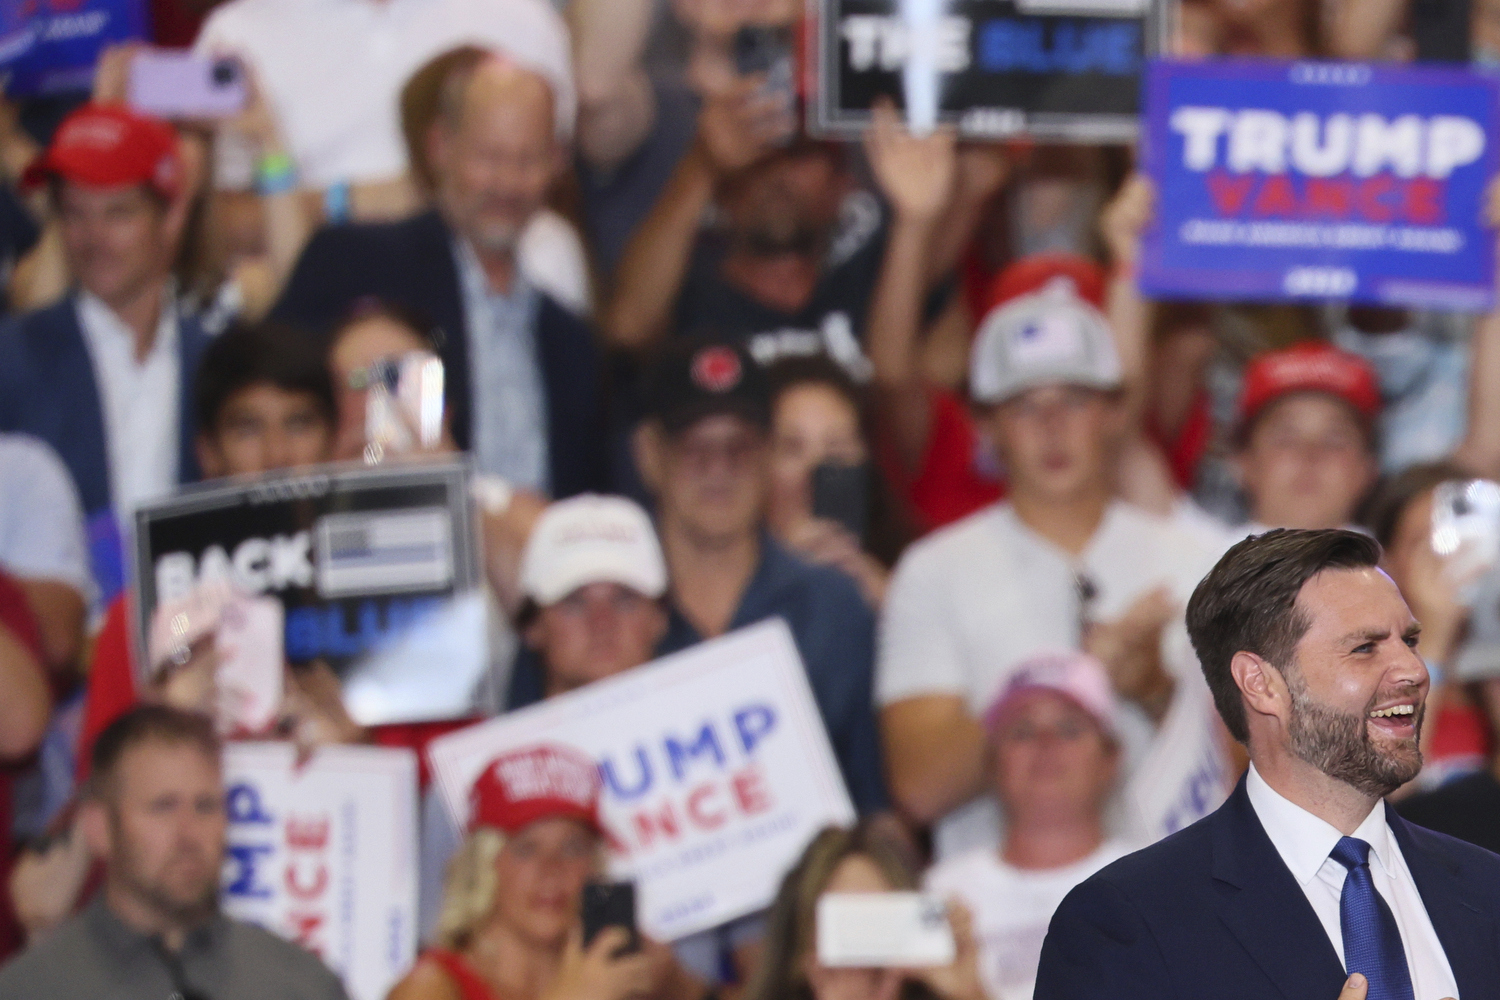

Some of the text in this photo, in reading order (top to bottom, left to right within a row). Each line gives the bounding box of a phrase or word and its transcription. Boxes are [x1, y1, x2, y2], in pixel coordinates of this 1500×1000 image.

[978, 17, 1141, 75] BLUE
[1169, 105, 1487, 180] TRUMP
[1204, 168, 1445, 226] VANCE
